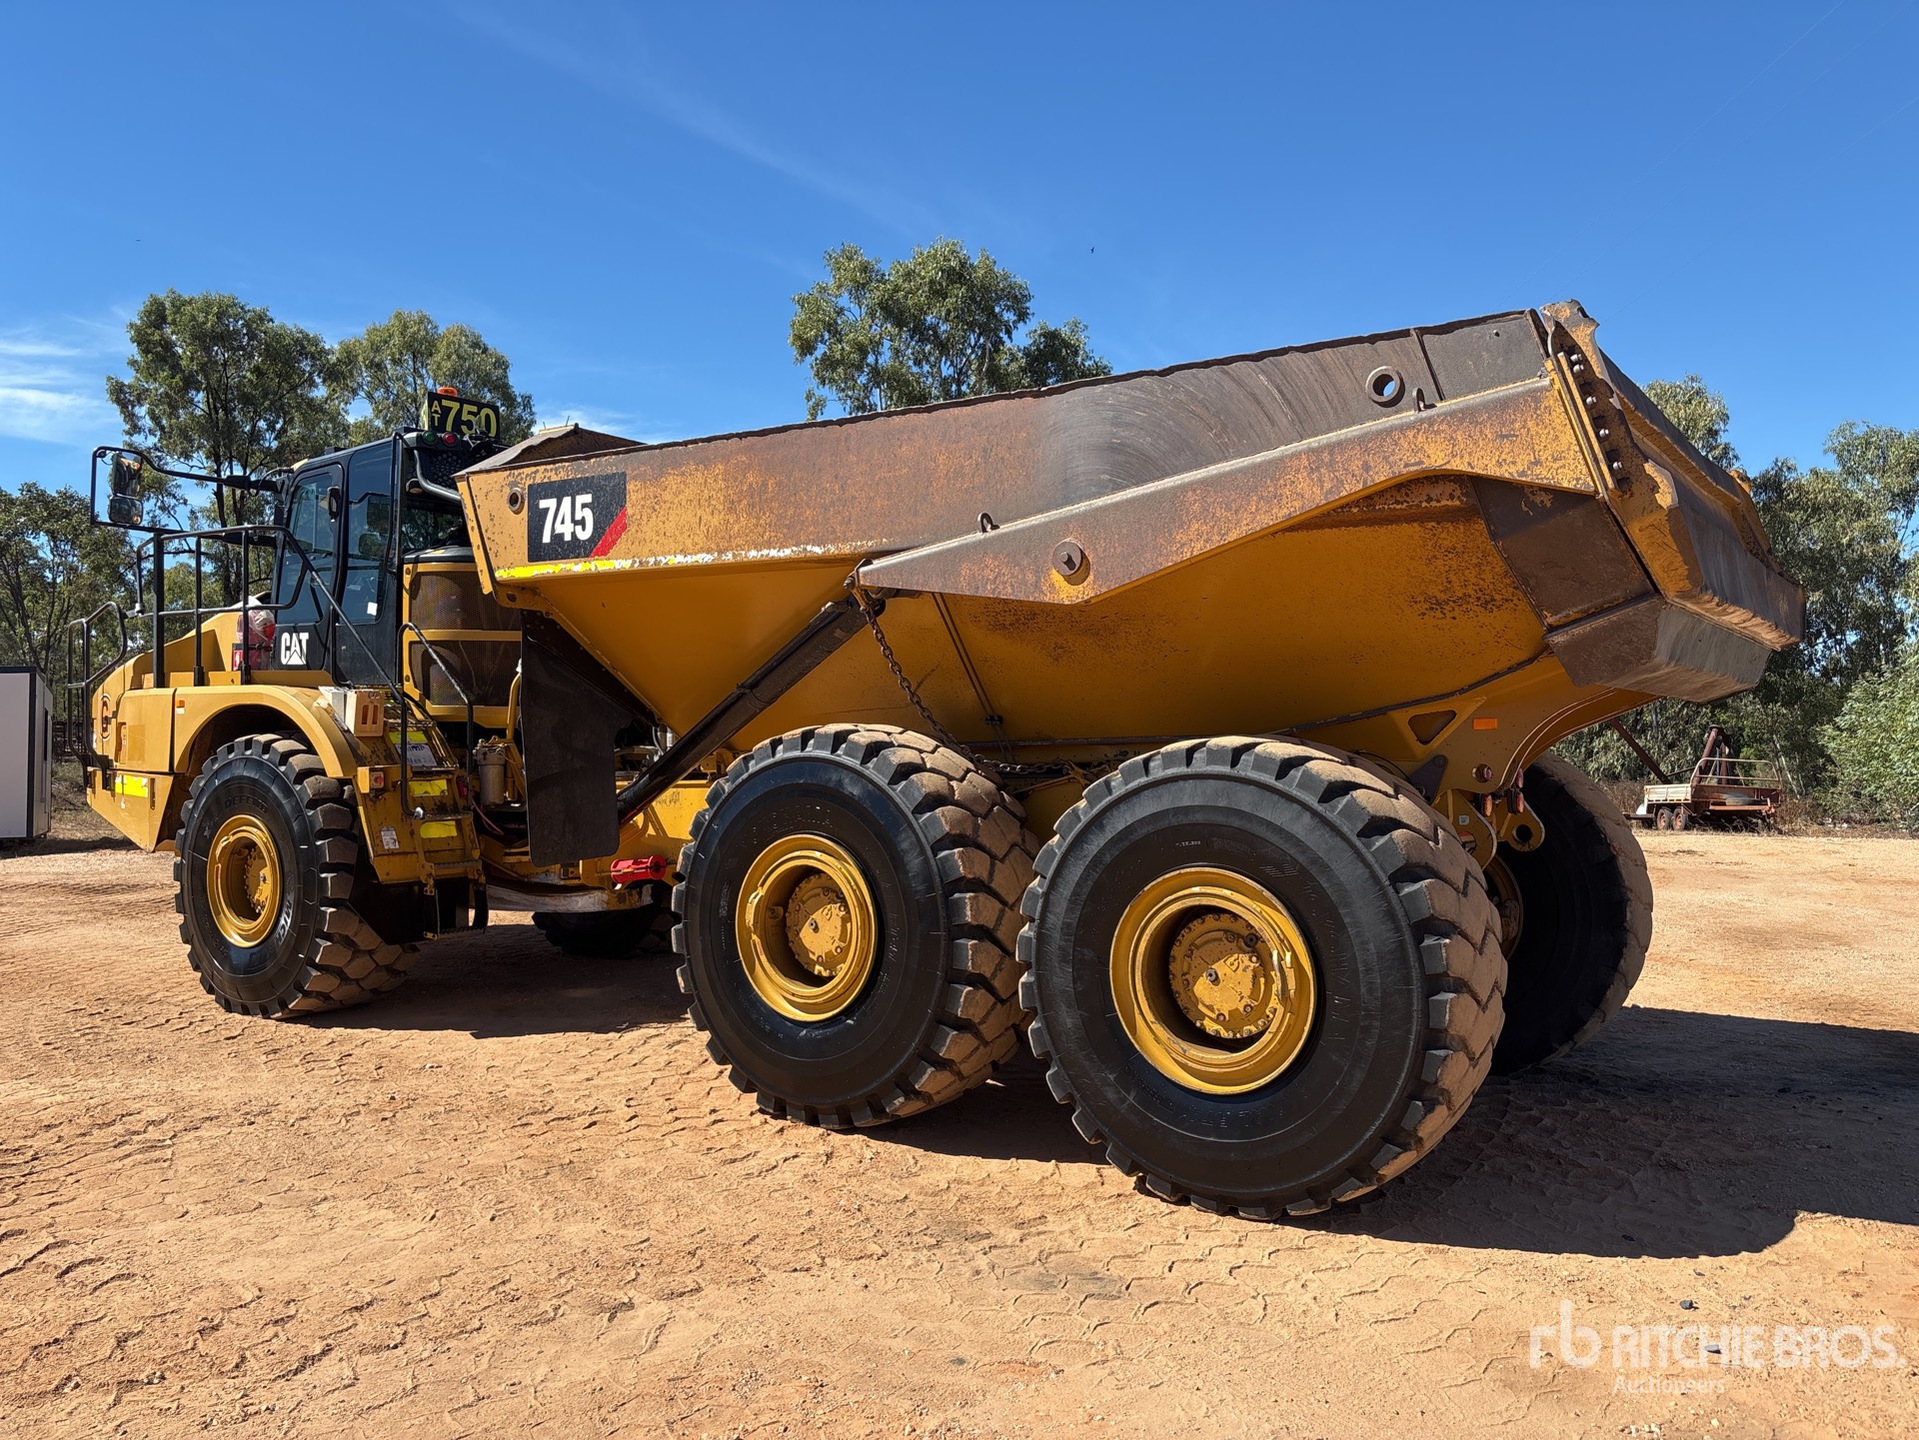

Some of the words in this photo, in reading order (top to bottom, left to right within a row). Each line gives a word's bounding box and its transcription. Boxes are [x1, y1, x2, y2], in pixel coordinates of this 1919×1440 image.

[441, 399, 497, 437] 750
[538, 493, 594, 543] 745
[280, 632, 309, 665] CAT
